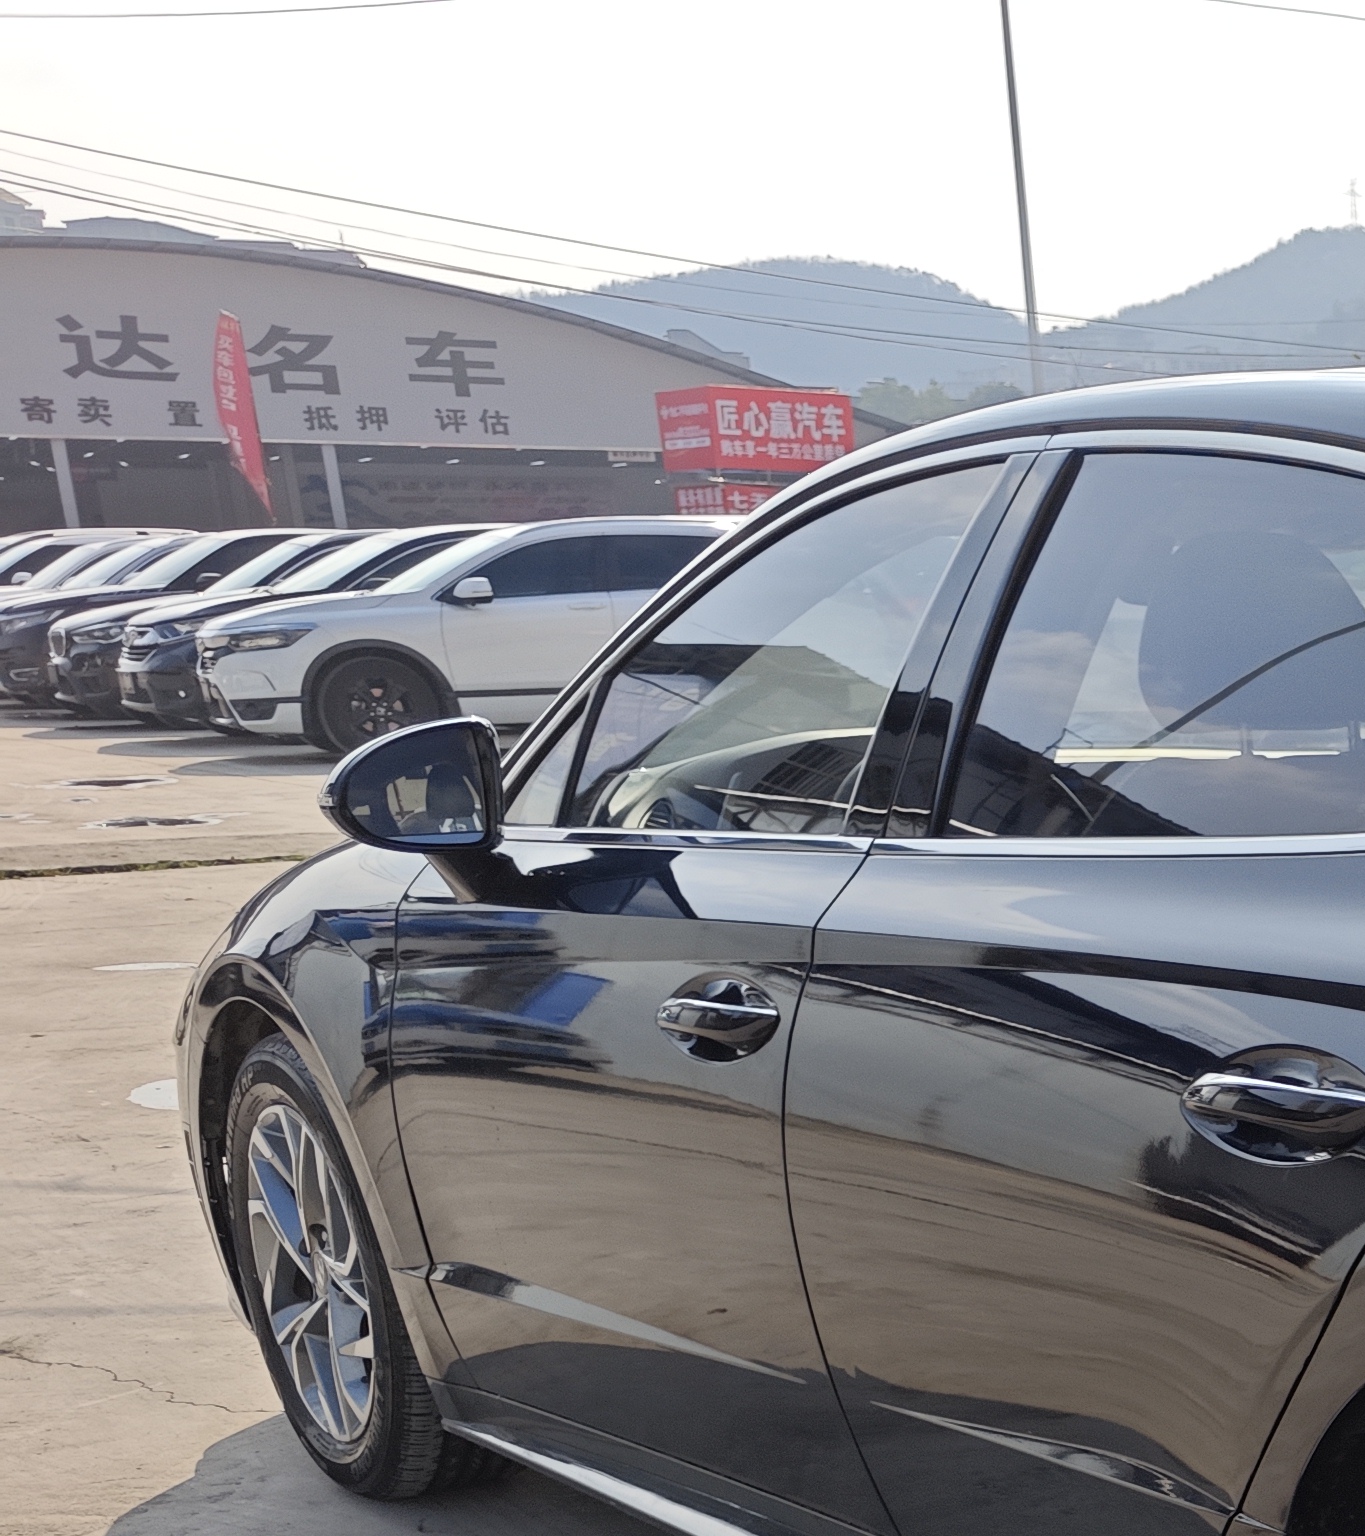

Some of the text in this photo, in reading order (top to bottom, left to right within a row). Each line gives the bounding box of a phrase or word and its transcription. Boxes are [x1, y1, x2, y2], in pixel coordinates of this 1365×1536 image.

[19, 396, 112, 427] 寄卖
[303, 405, 389, 432] 抵押
[434, 408, 510, 436] 评估
[715, 399, 847, 442] 匠心赢汽车
